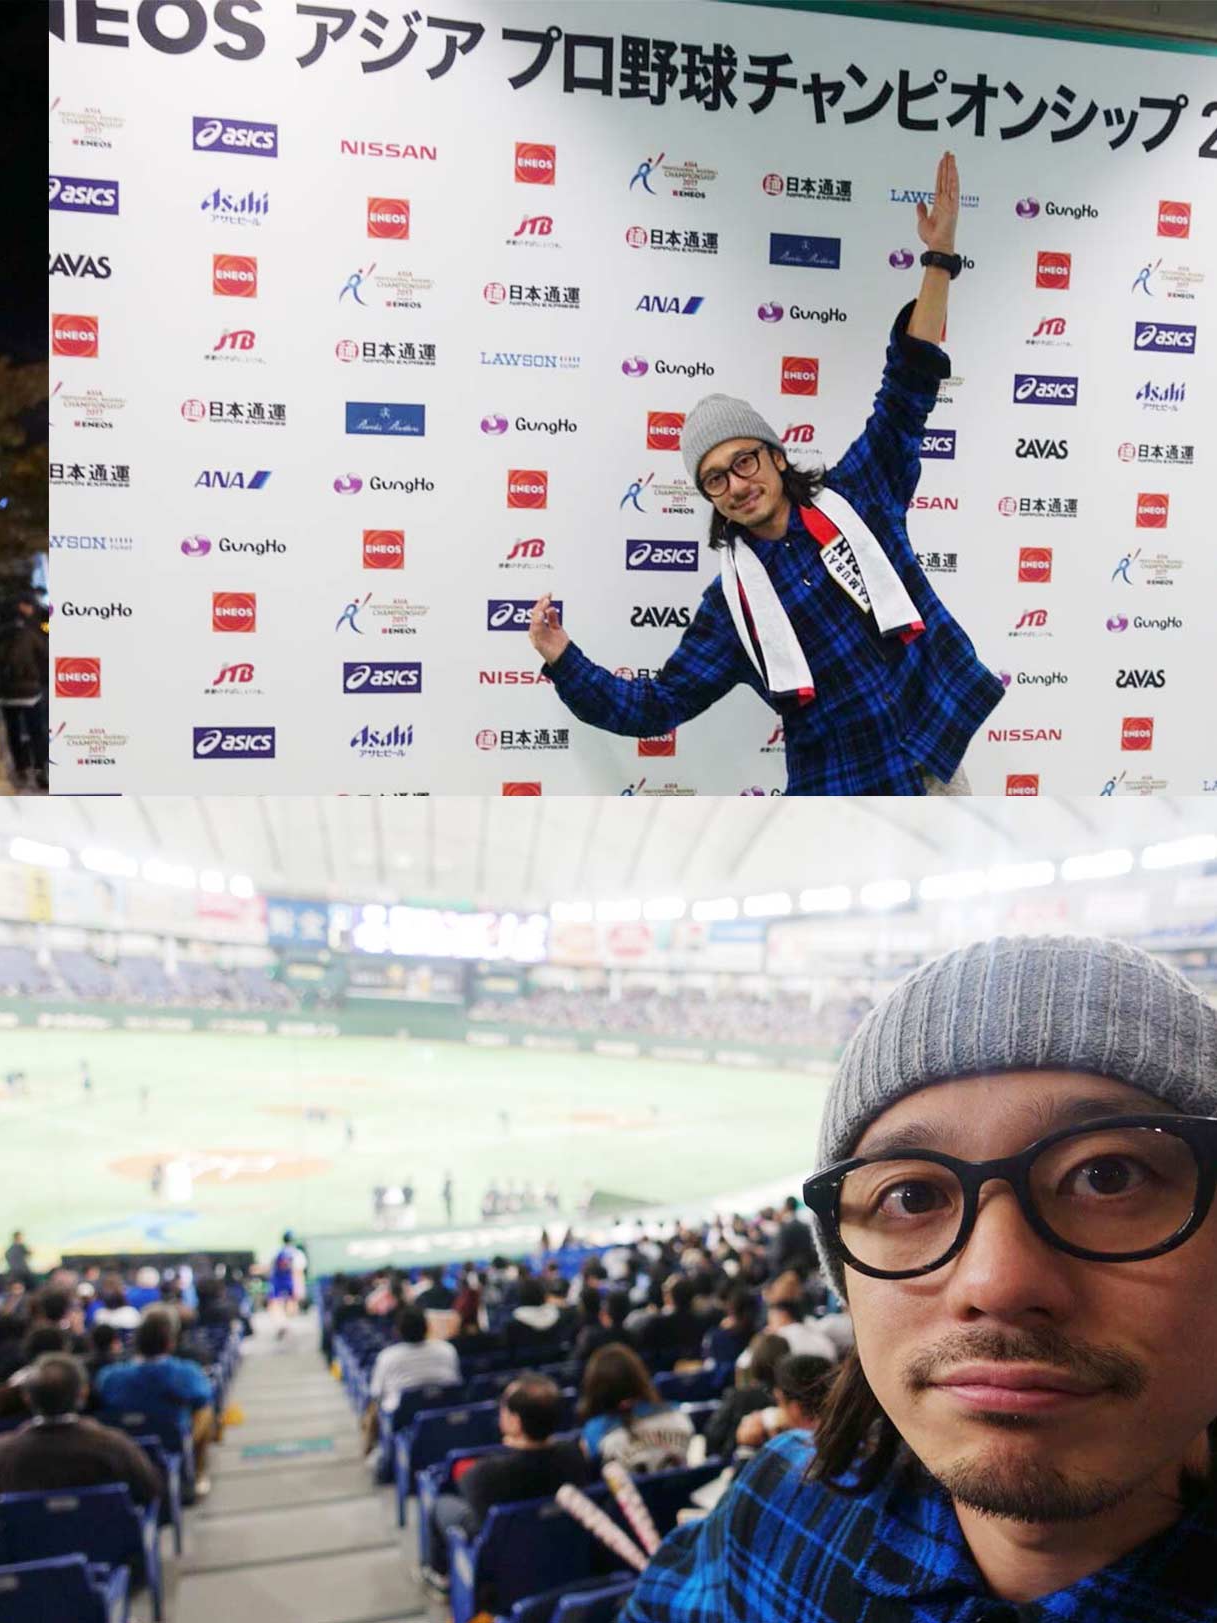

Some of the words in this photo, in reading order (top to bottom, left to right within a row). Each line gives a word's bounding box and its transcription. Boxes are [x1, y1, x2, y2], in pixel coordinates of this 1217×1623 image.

[49, 0, 266, 61] EOS
[294, 3, 486, 80] アジア
[501, 25, 1190, 152] プロ野球チャンピオンシップ
[222, 127, 274, 149] asics
[341, 141, 436, 160] NISSAN
[517, 157, 552, 169] ENEOS
[678, 190, 706, 199] ENEOS
[786, 176, 851, 196] 日本通運
[60, 186, 115, 206] asics
[201, 189, 268, 213] Asahi
[890, 189, 937, 206] LAWS
[369, 212, 406, 224] ENEOS
[1045, 202, 1098, 219] GungHo
[1160, 214, 1188, 224] ENEOS
[514, 216, 553, 236] JTB
[650, 229, 718, 250] 日本通運
[49, 253, 112, 280] AVAS
[216, 269, 256, 281] ENEOS
[1039, 266, 1068, 275] ENEOS
[509, 285, 580, 304] 日本通運
[636, 296, 679, 314] ANA
[790, 306, 847, 323] GungHo
[55, 330, 95, 341] ENEOS
[1033, 318, 1066, 337] JTB
[214, 330, 255, 351] JTB
[1157, 328, 1193, 347] asics
[363, 343, 435, 361] 日本通運
[480, 351, 558, 369] LAWSON
[655, 360, 714, 377] GungHo
[784, 371, 815, 380] ENEOS
[1036, 381, 1075, 398] asics
[1136, 382, 1185, 401] Asahi
[209, 402, 286, 421] 日本通運
[516, 417, 577, 434] GungHo
[650, 426, 683, 438] ENEOS
[782, 424, 814, 443] JTB
[921, 437, 953, 451] sics
[1016, 438, 1068, 459] SAVAS
[1138, 445, 1194, 460] 日本通運
[50, 464, 130, 483] 日本通運
[195, 471, 244, 488] ANA
[370, 477, 434, 493] GungHo
[510, 484, 544, 496] ENEOS
[909, 496, 958, 510] SSAN
[1019, 498, 1078, 513] 日本通運
[1139, 507, 1166, 515] ENEOS
[219, 538, 286, 555] GungHo
[366, 545, 401, 553] ENEOS
[507, 539, 545, 560] JTB
[650, 547, 695, 564] asics
[915, 553, 958, 569] 本通運
[62, 602, 132, 619] GungHo
[215, 605, 253, 616] ENEOS
[631, 607, 691, 629] SAVAS
[1016, 610, 1047, 629] JTB
[1134, 616, 1182, 630] GungHo
[388, 627, 417, 635] ENEOS
[58, 673, 97, 681] ENEOS
[213, 663, 254, 685] JTB
[370, 670, 419, 685] asics
[480, 669, 550, 683] NISSA
[1017, 672, 1068, 686] GungHo
[1116, 670, 1165, 688] SAVAS
[351, 725, 412, 747] Asahi
[500, 729, 568, 746] 日本通運
[988, 729, 1061, 742] NISSAN
[1122, 728, 1150, 737] ENEOS
[222, 732, 272, 751] asics
